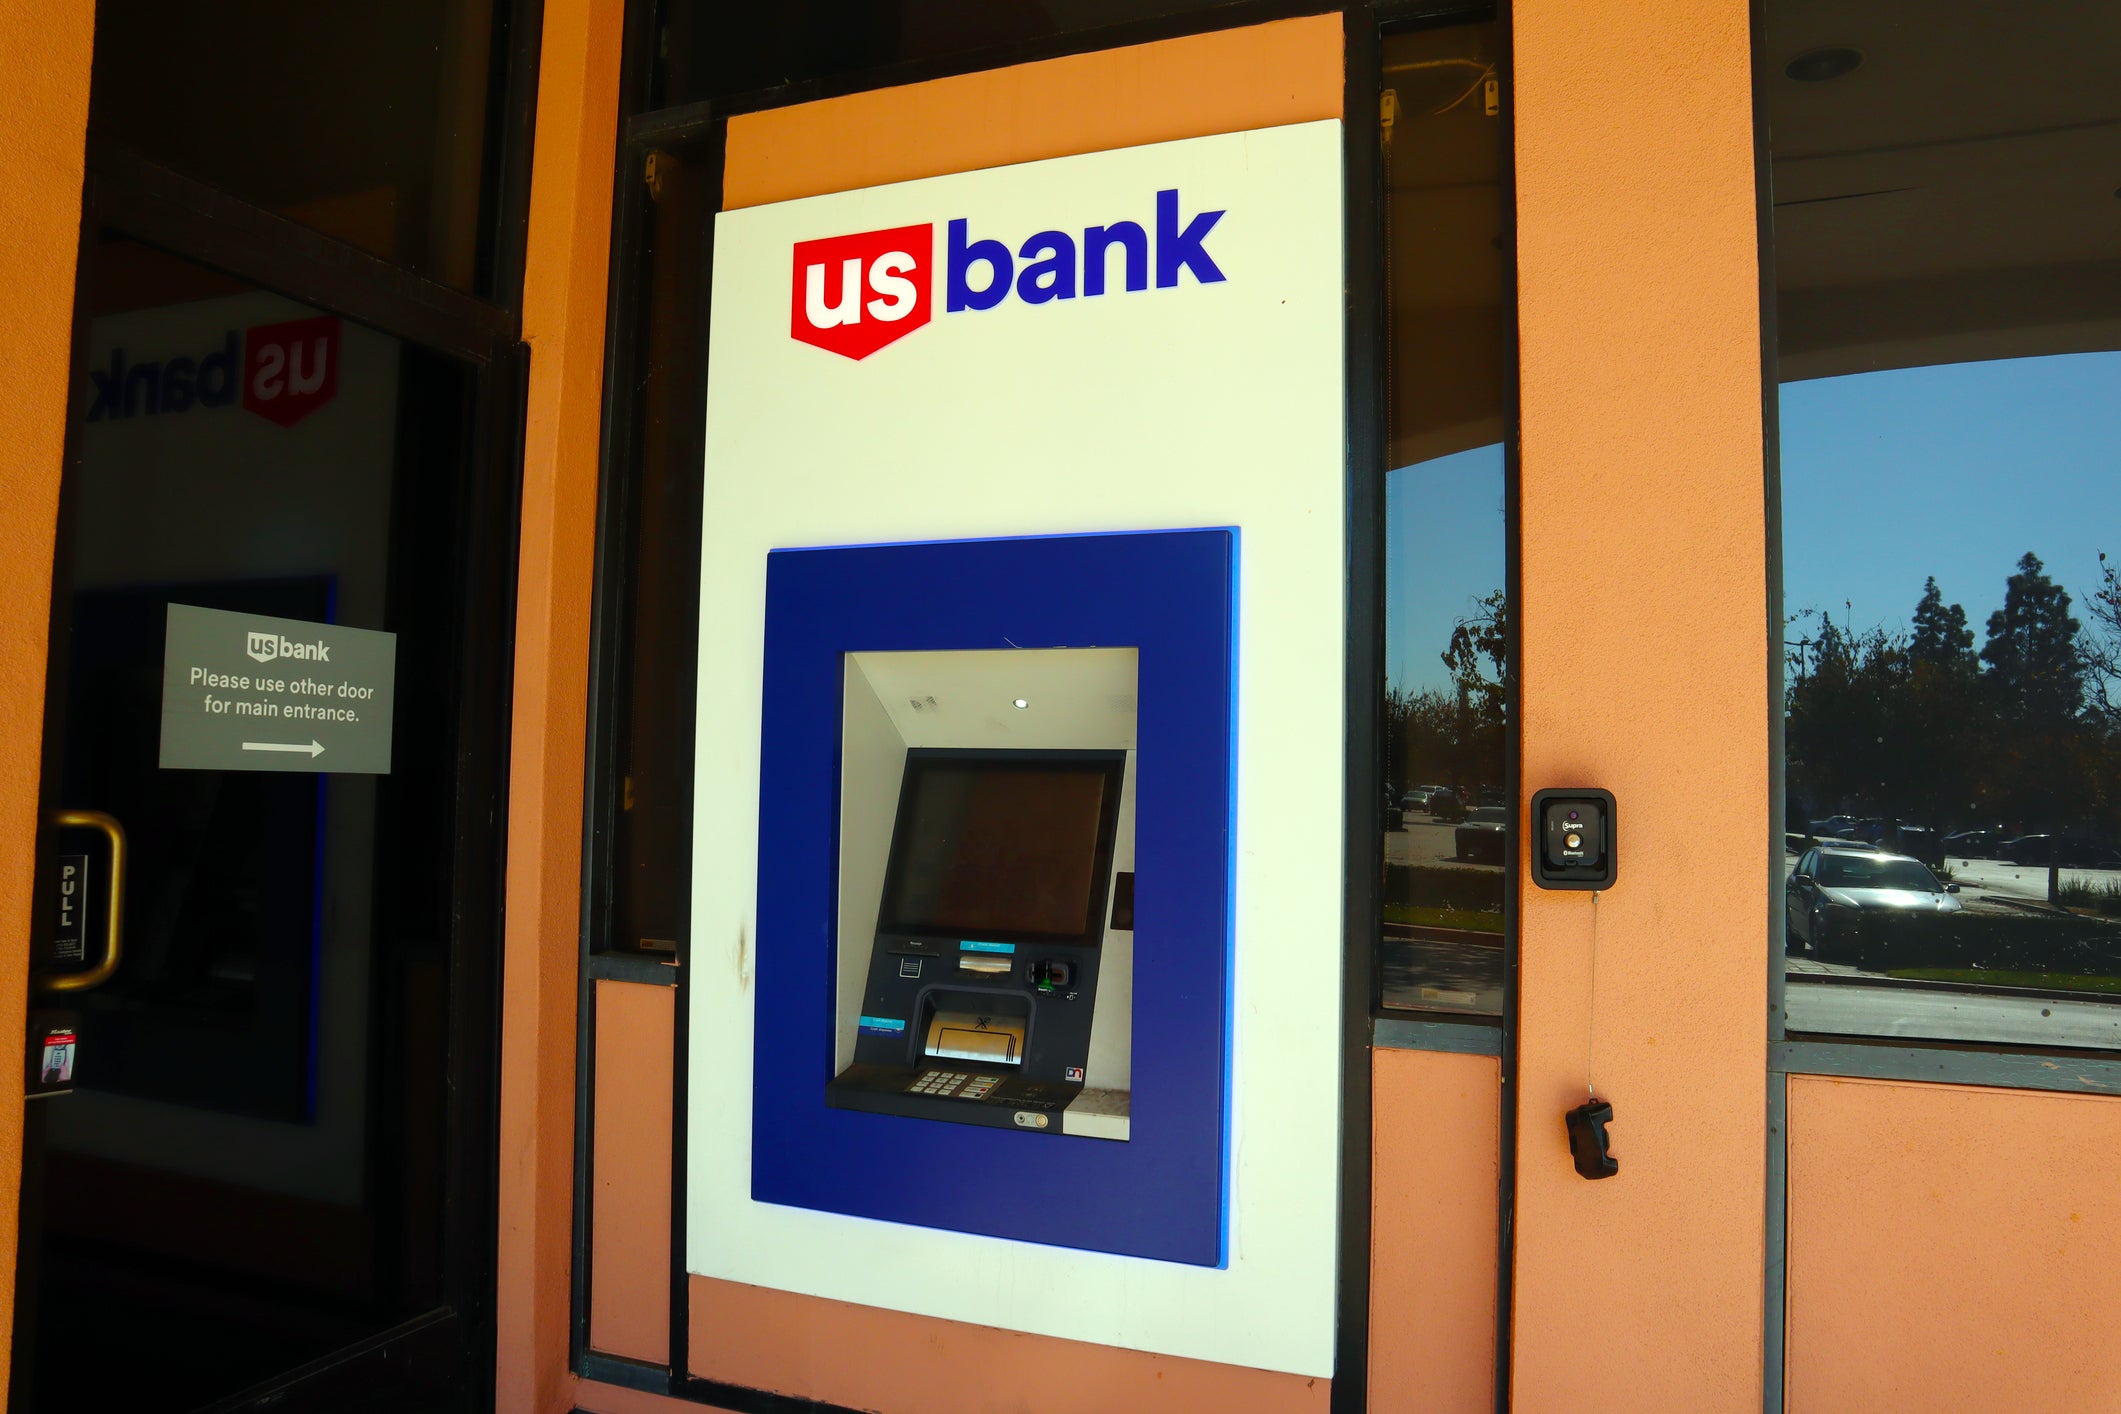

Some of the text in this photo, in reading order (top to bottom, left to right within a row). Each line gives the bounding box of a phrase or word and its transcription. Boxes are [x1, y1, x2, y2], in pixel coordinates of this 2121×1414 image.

[806, 188, 1227, 329] us bank
[250, 635, 330, 662] us bank
[190, 666, 374, 700] Please use other door
[204, 694, 360, 722] for main entrance.
[1564, 822, 1583, 830] Supra
[61, 865, 76, 926] PULL
